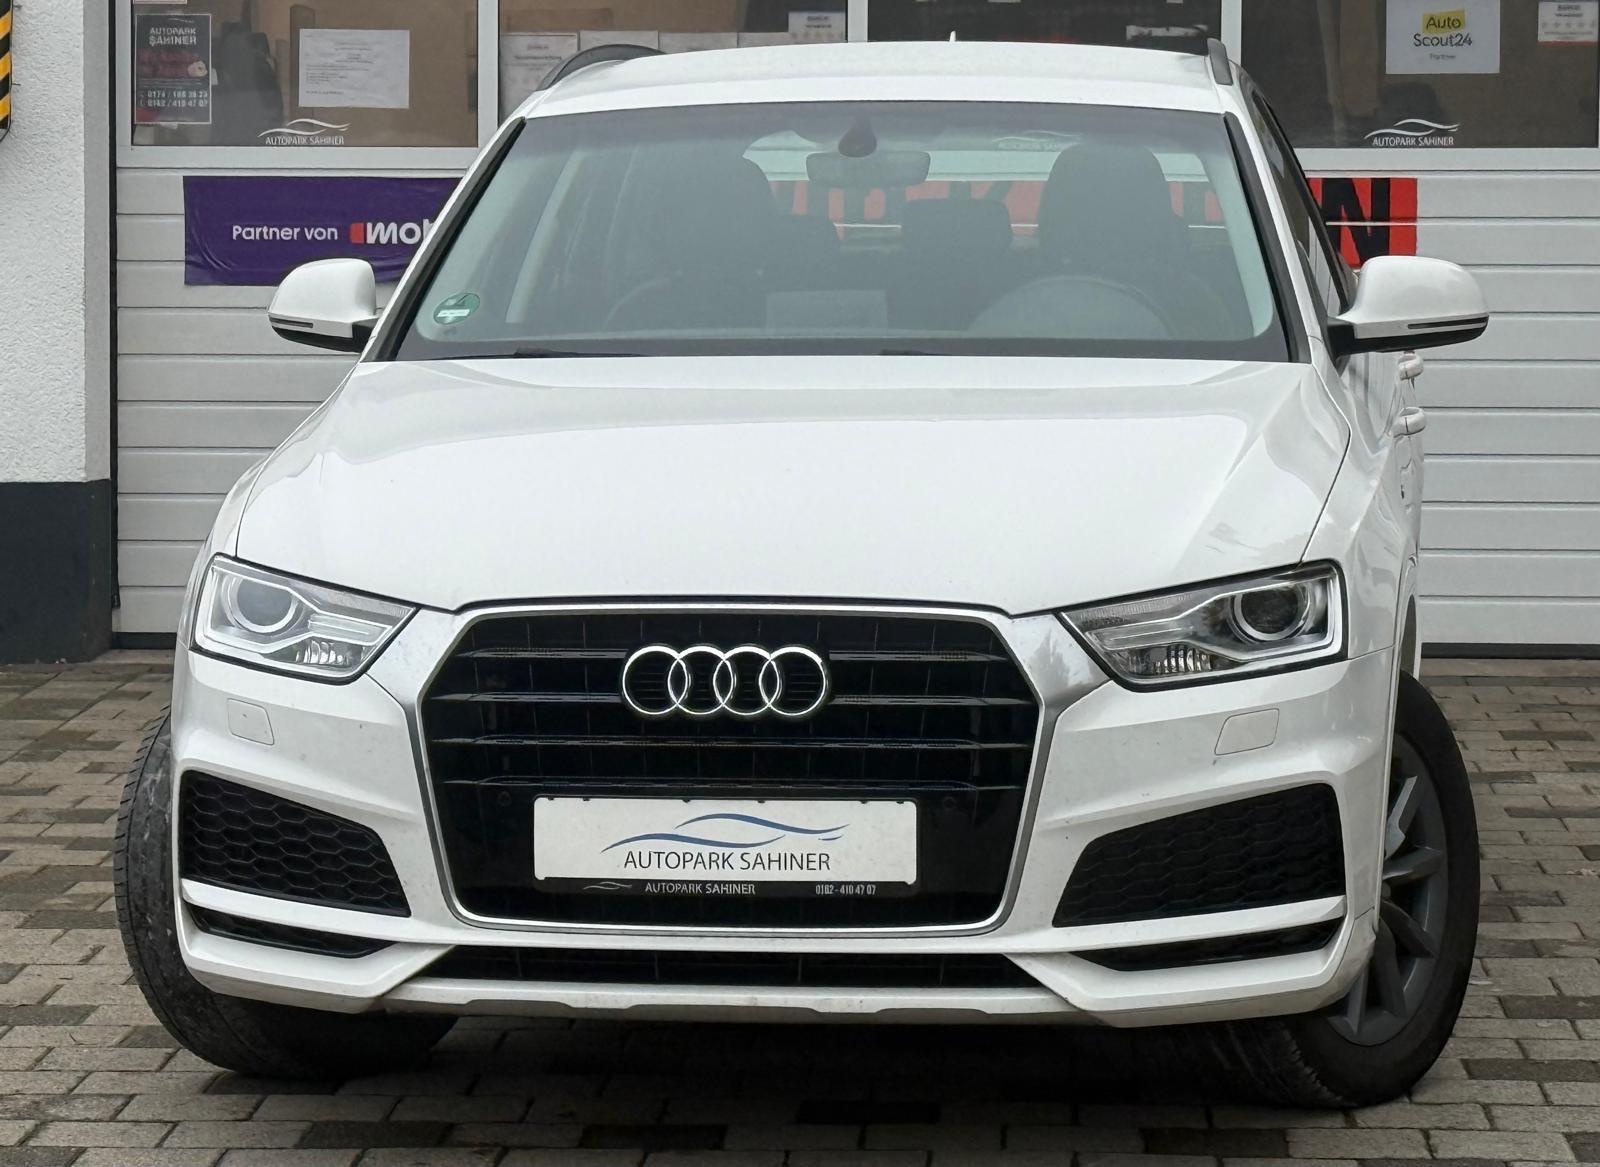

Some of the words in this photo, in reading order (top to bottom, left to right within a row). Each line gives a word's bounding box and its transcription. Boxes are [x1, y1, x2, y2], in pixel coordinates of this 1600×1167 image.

[1426, 16, 1462, 30] Auto
[149, 27, 197, 35] AUTOPARK
[1413, 33, 1473, 47] Scout24
[265, 135, 308, 145] AUTOPARK
[1372, 136, 1416, 146] AUTOPARK
[232, 225, 300, 241] Partner
[304, 227, 338, 241] von
[624, 850, 734, 870] AUTOPARK
[739, 852, 831, 871] SAHINER
[645, 882, 703, 894] AUTOPARK
[705, 883, 756, 895] SAHINER
